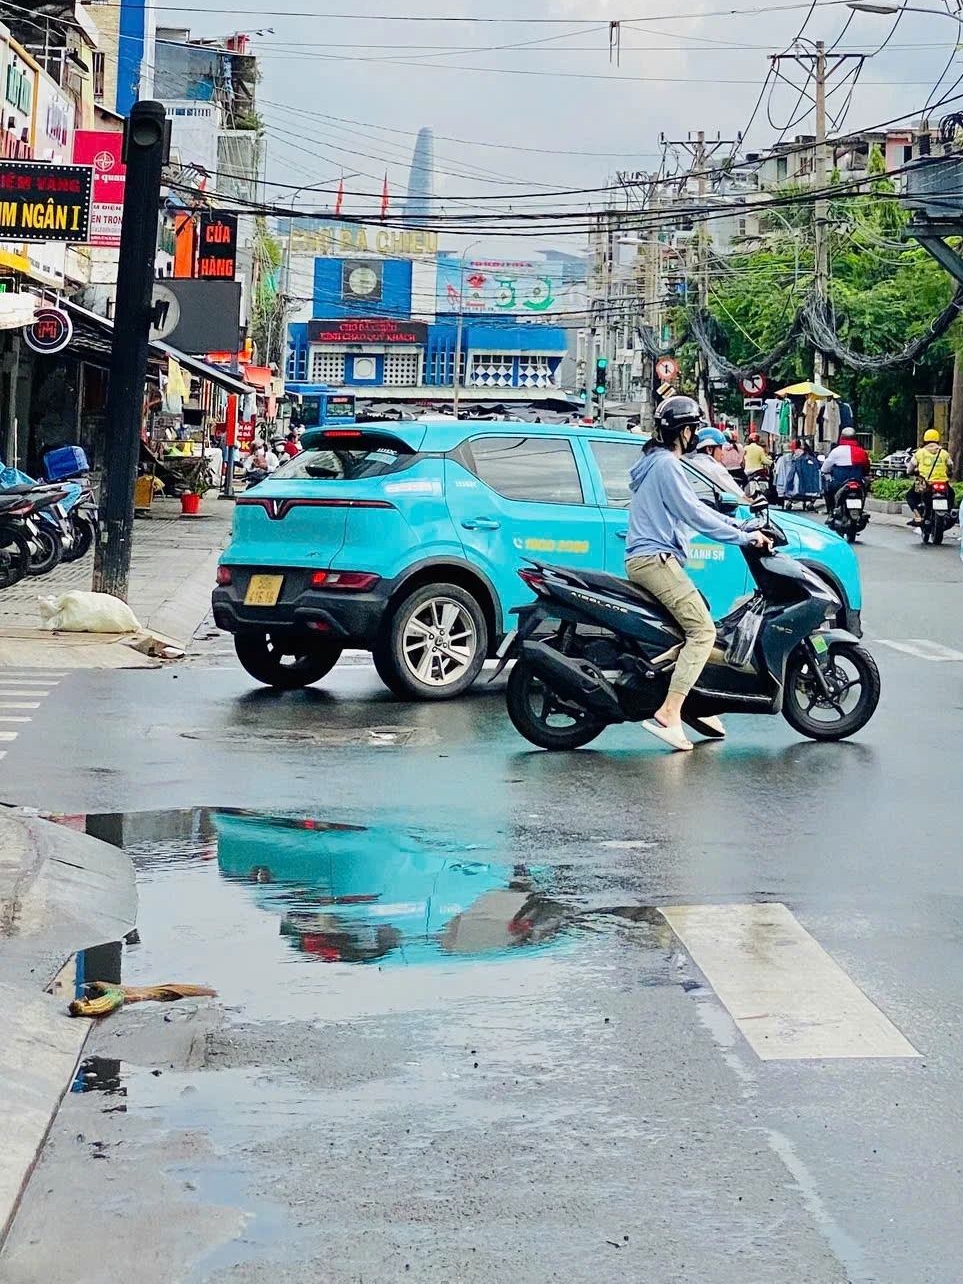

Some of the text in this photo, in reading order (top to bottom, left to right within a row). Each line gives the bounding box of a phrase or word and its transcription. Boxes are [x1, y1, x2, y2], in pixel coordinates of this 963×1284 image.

[21, 197, 68, 230] NGÂN
[205, 221, 231, 243] CỬA
[201, 255, 233, 278] HÀNG
